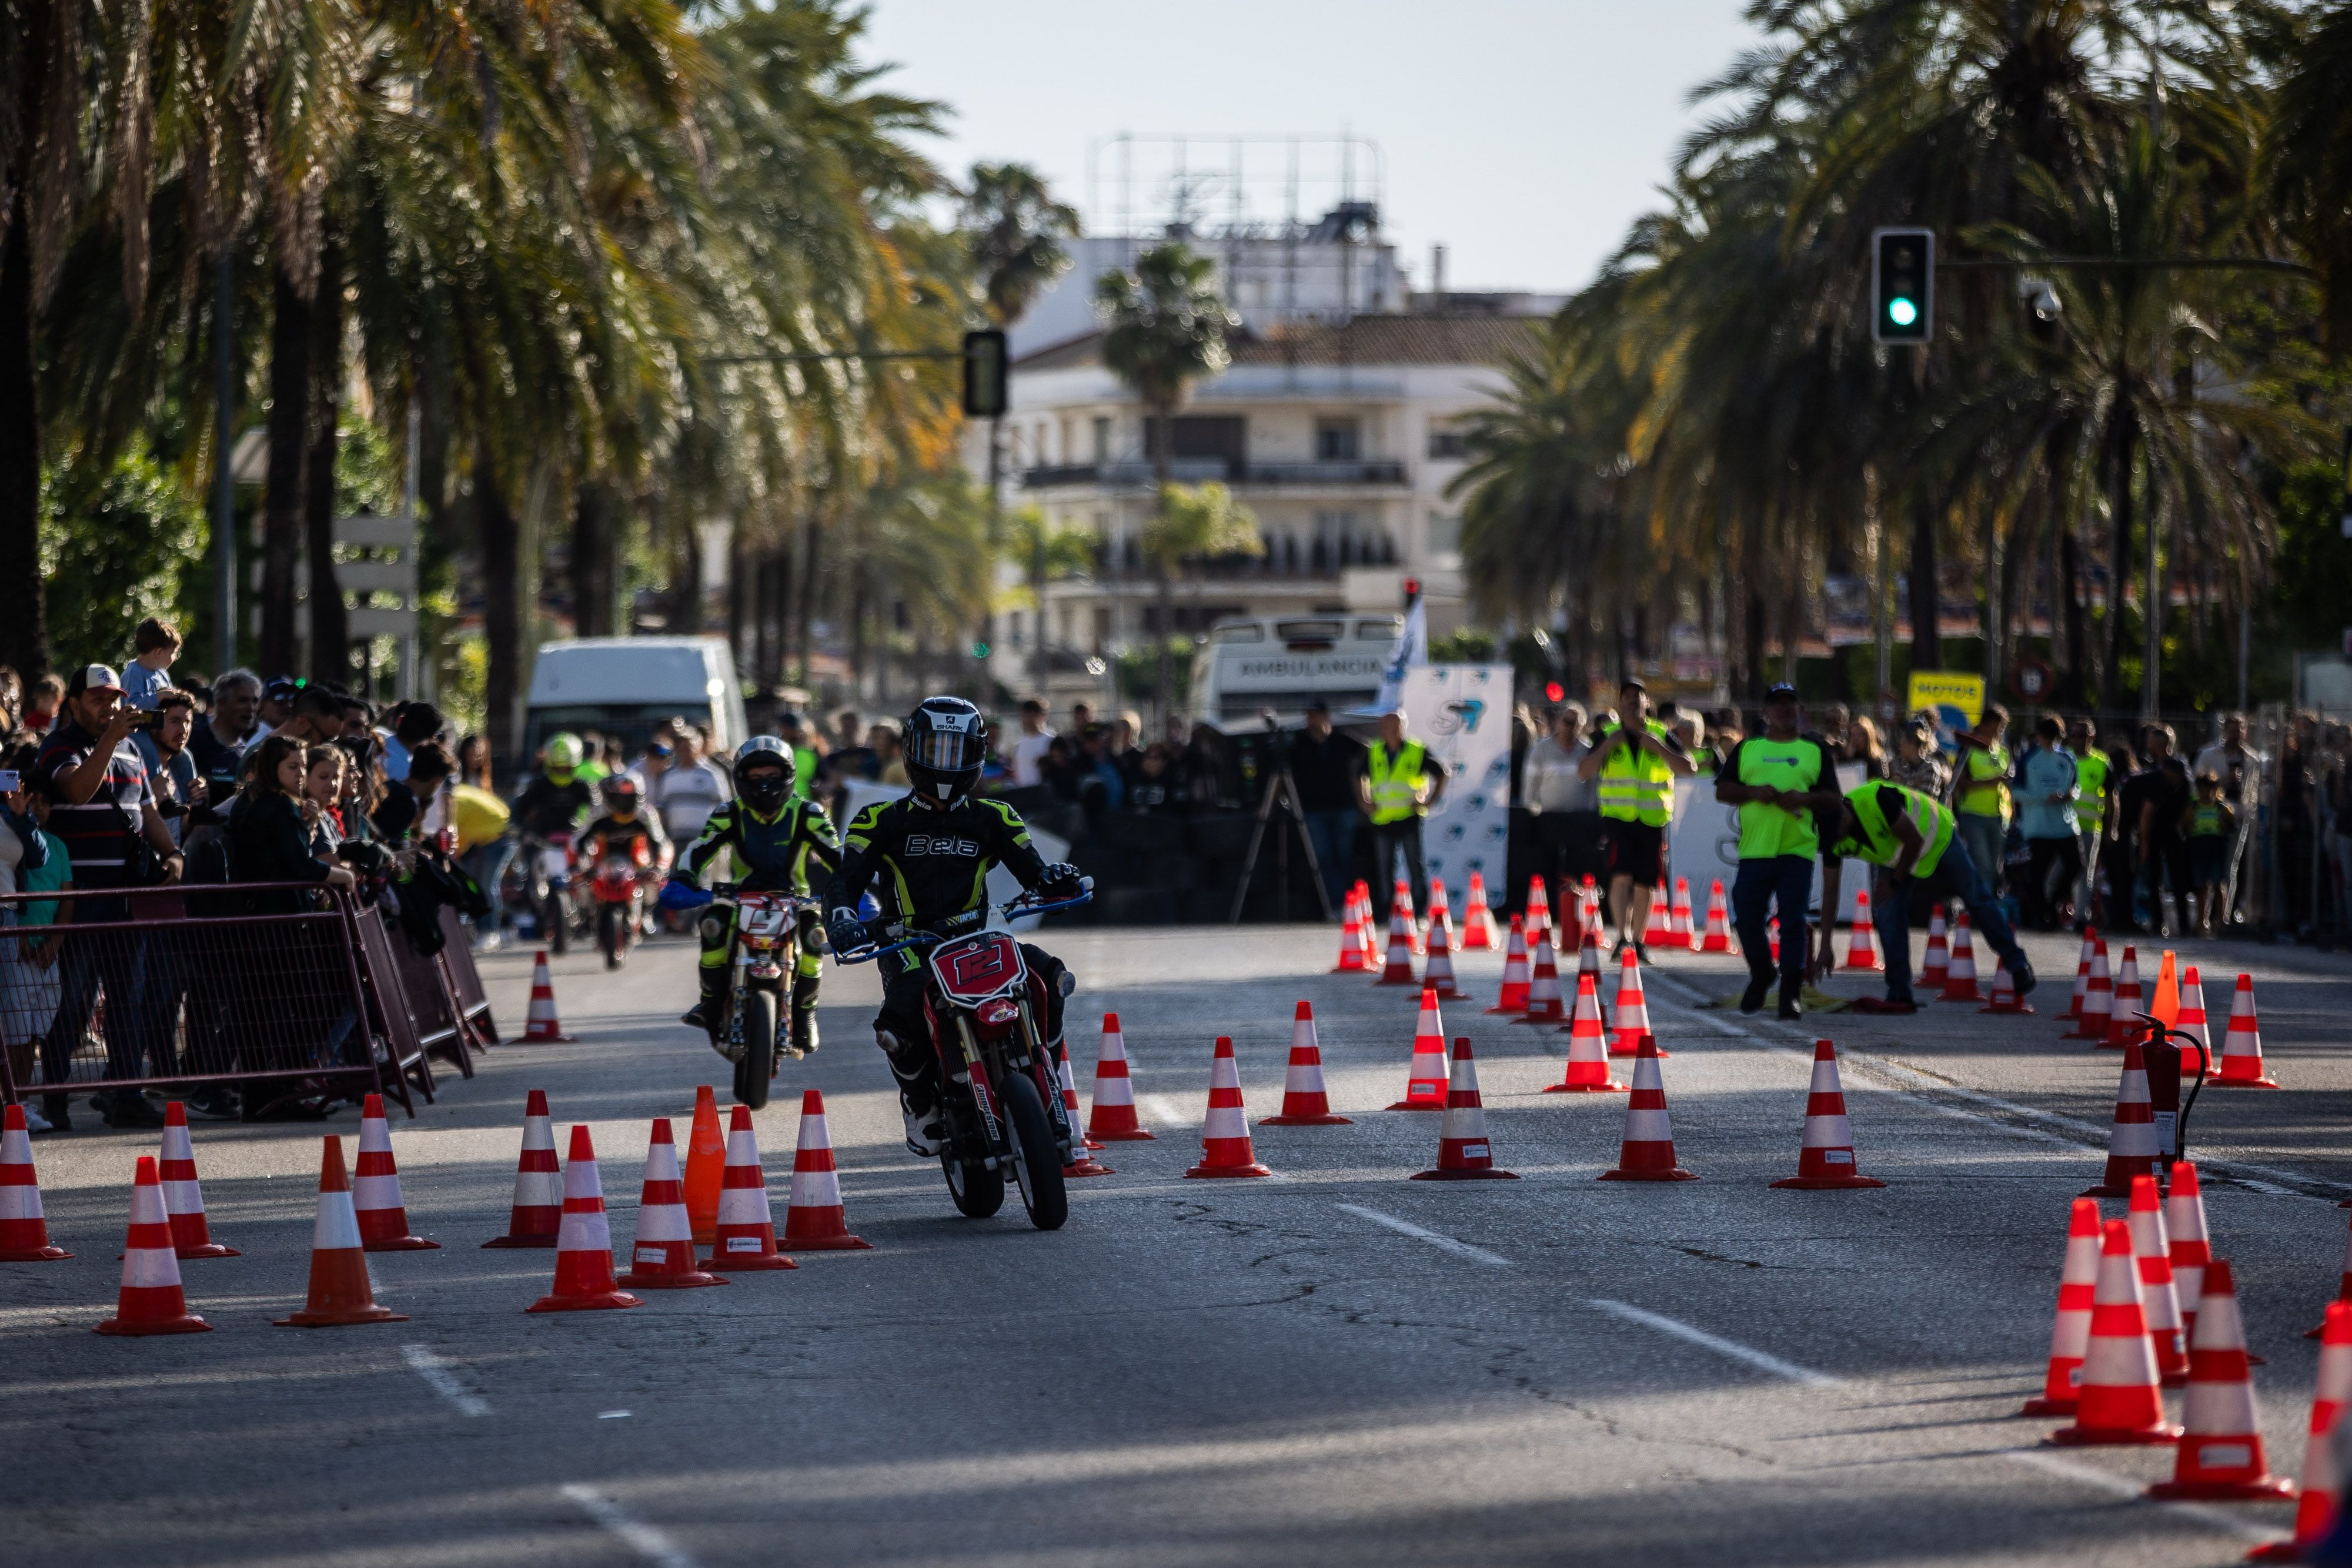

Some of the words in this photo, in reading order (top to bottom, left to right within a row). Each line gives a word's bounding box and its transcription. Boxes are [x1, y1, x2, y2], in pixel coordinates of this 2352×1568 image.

[1241, 658, 1383, 677] AMBULANCIA
[911, 795, 932, 811] Bela
[950, 794, 965, 811] Bela
[904, 835, 978, 857] Bela
[954, 945, 1003, 987] 12
[975, 1084, 1000, 1141] BRIDGESTONE
